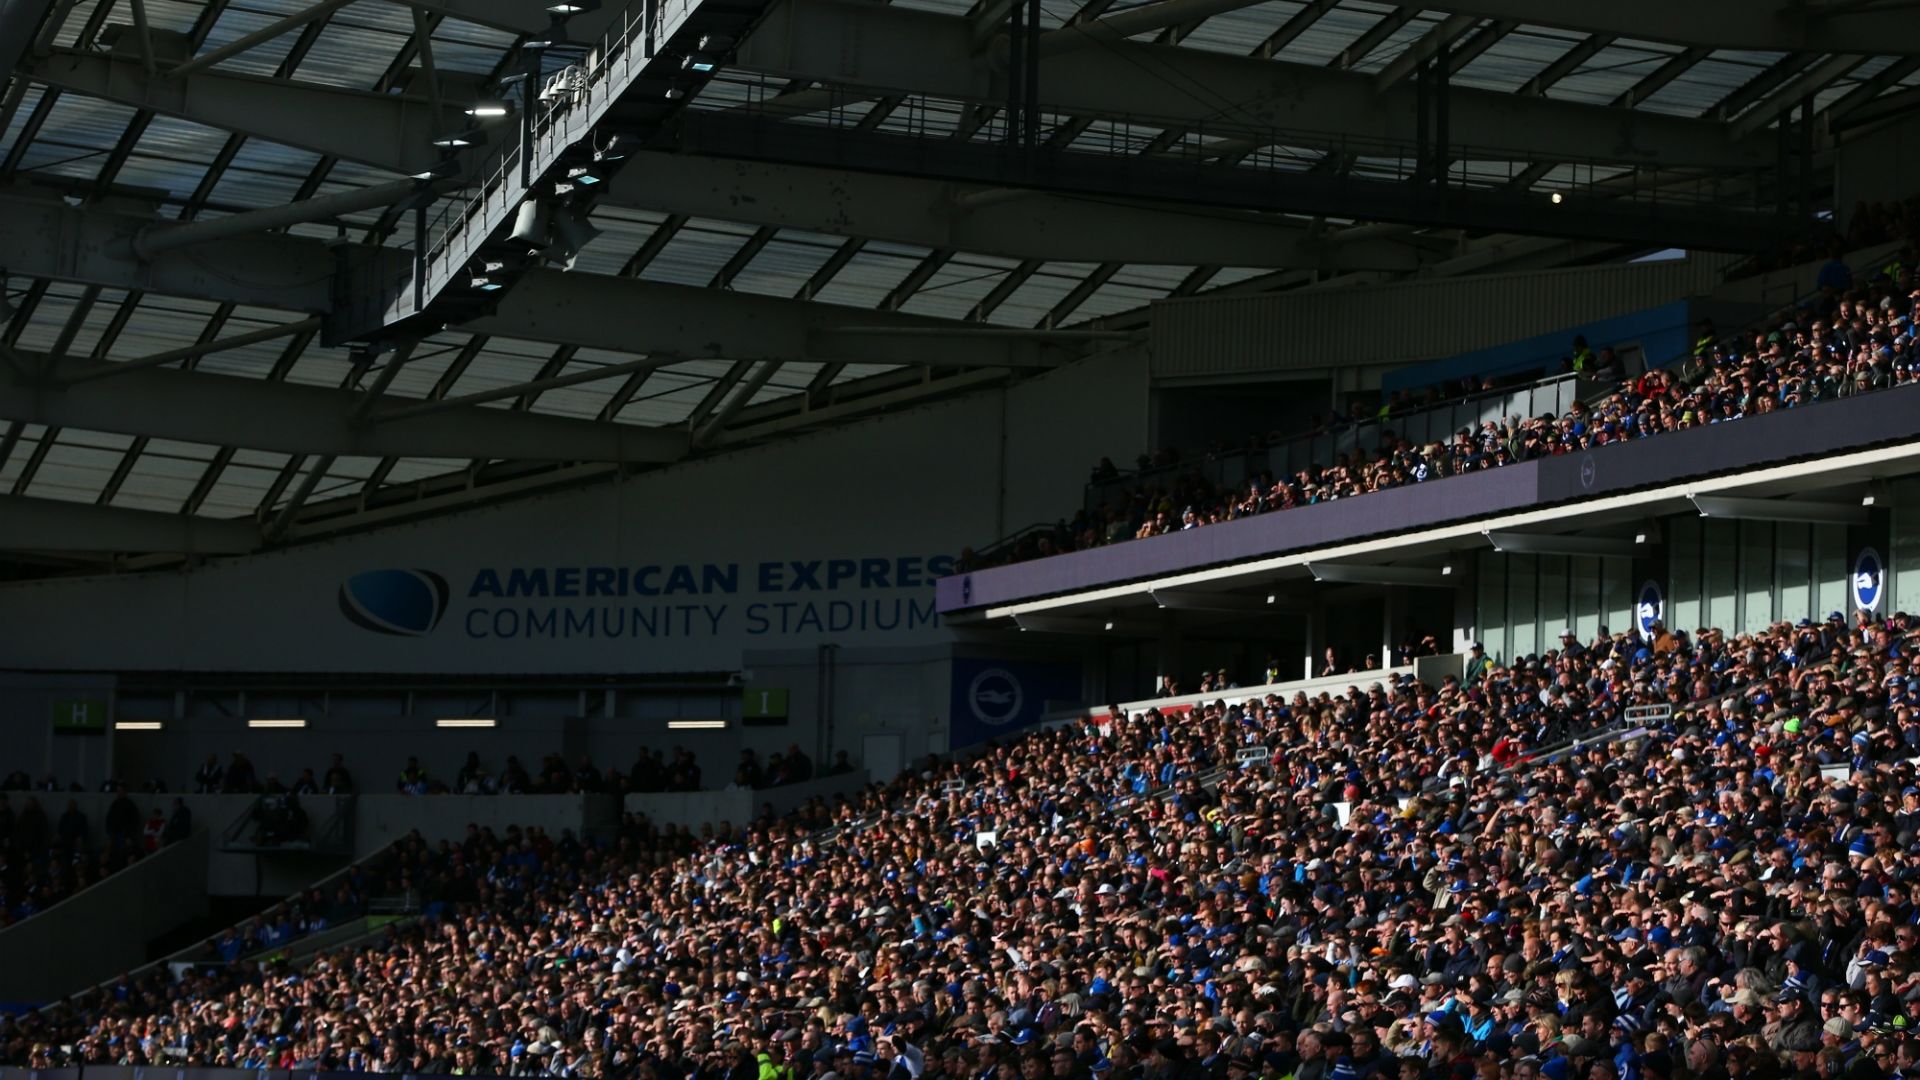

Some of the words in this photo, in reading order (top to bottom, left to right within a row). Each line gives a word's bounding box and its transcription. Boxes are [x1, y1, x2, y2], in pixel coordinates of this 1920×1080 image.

[469, 563, 738, 598] AMERICAN
[466, 605, 728, 639] COMMUNITY
[746, 598, 939, 634] STADIUM
[72, 703, 88, 724] H
